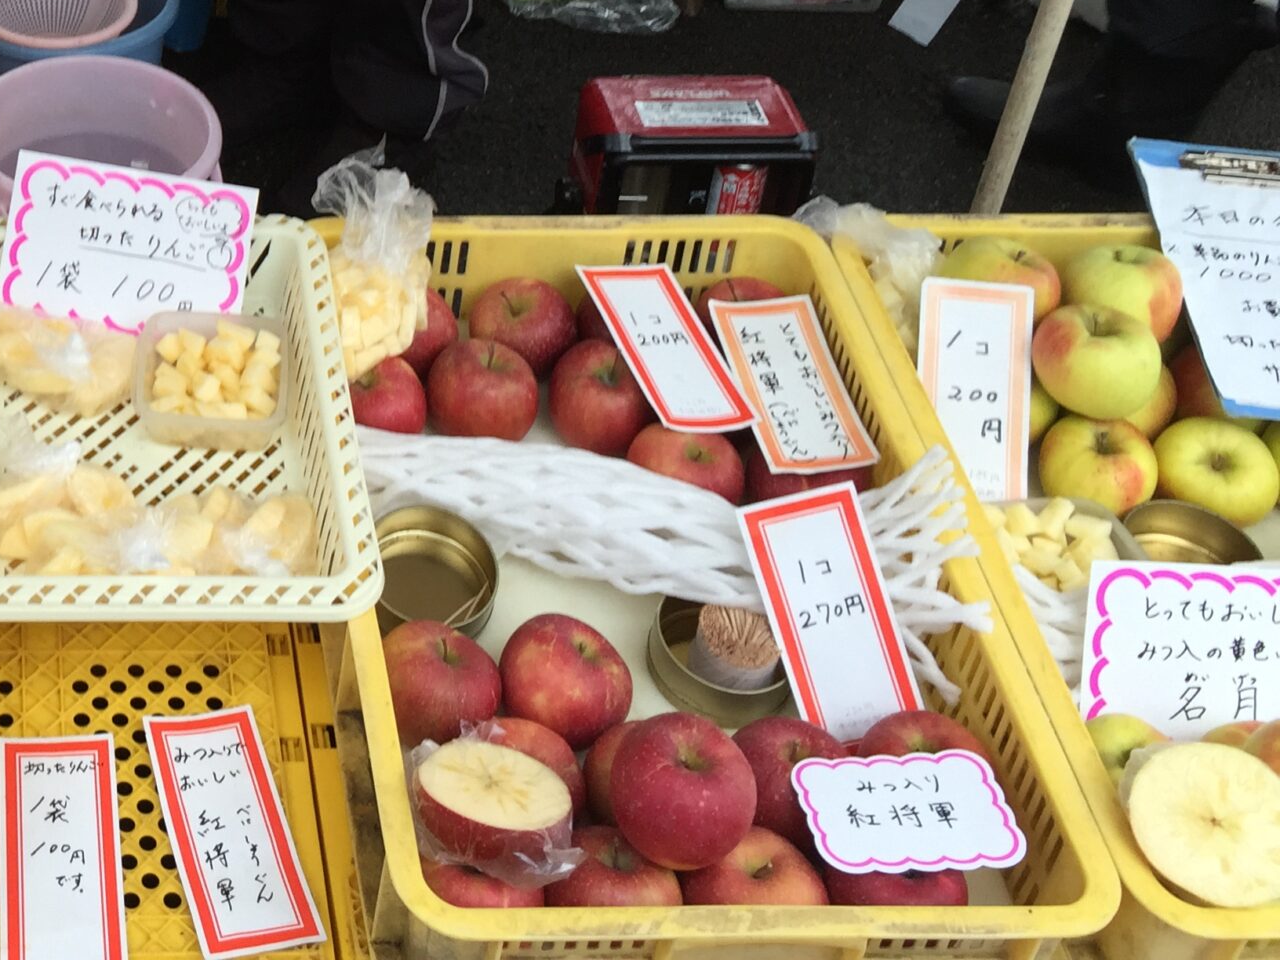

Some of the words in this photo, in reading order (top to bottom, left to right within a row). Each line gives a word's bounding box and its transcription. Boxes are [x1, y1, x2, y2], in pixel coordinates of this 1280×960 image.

[47, 183, 163, 222] すぐ食べられる
[36, 260, 82, 294] 1袋
[629, 311, 663, 326] 1コ
[638, 332, 692, 347] 200円
[946, 330, 989, 356] 1コ
[947, 384, 998, 403] 200
[980, 417, 1004, 443] 円
[798, 559, 833, 585] 1コ
[799, 593, 867, 630] 270円
[1169, 685, 1258, 722] 名月
[23, 759, 105, 776] 切ったりんご
[179, 769, 241, 791] おいしい
[856, 773, 942, 794] みつ入り
[29, 795, 71, 824] 1袋
[845, 800, 959, 831] 紅将軍
[29, 841, 87, 865] 100円
[197, 809, 237, 912] 紅将軍
